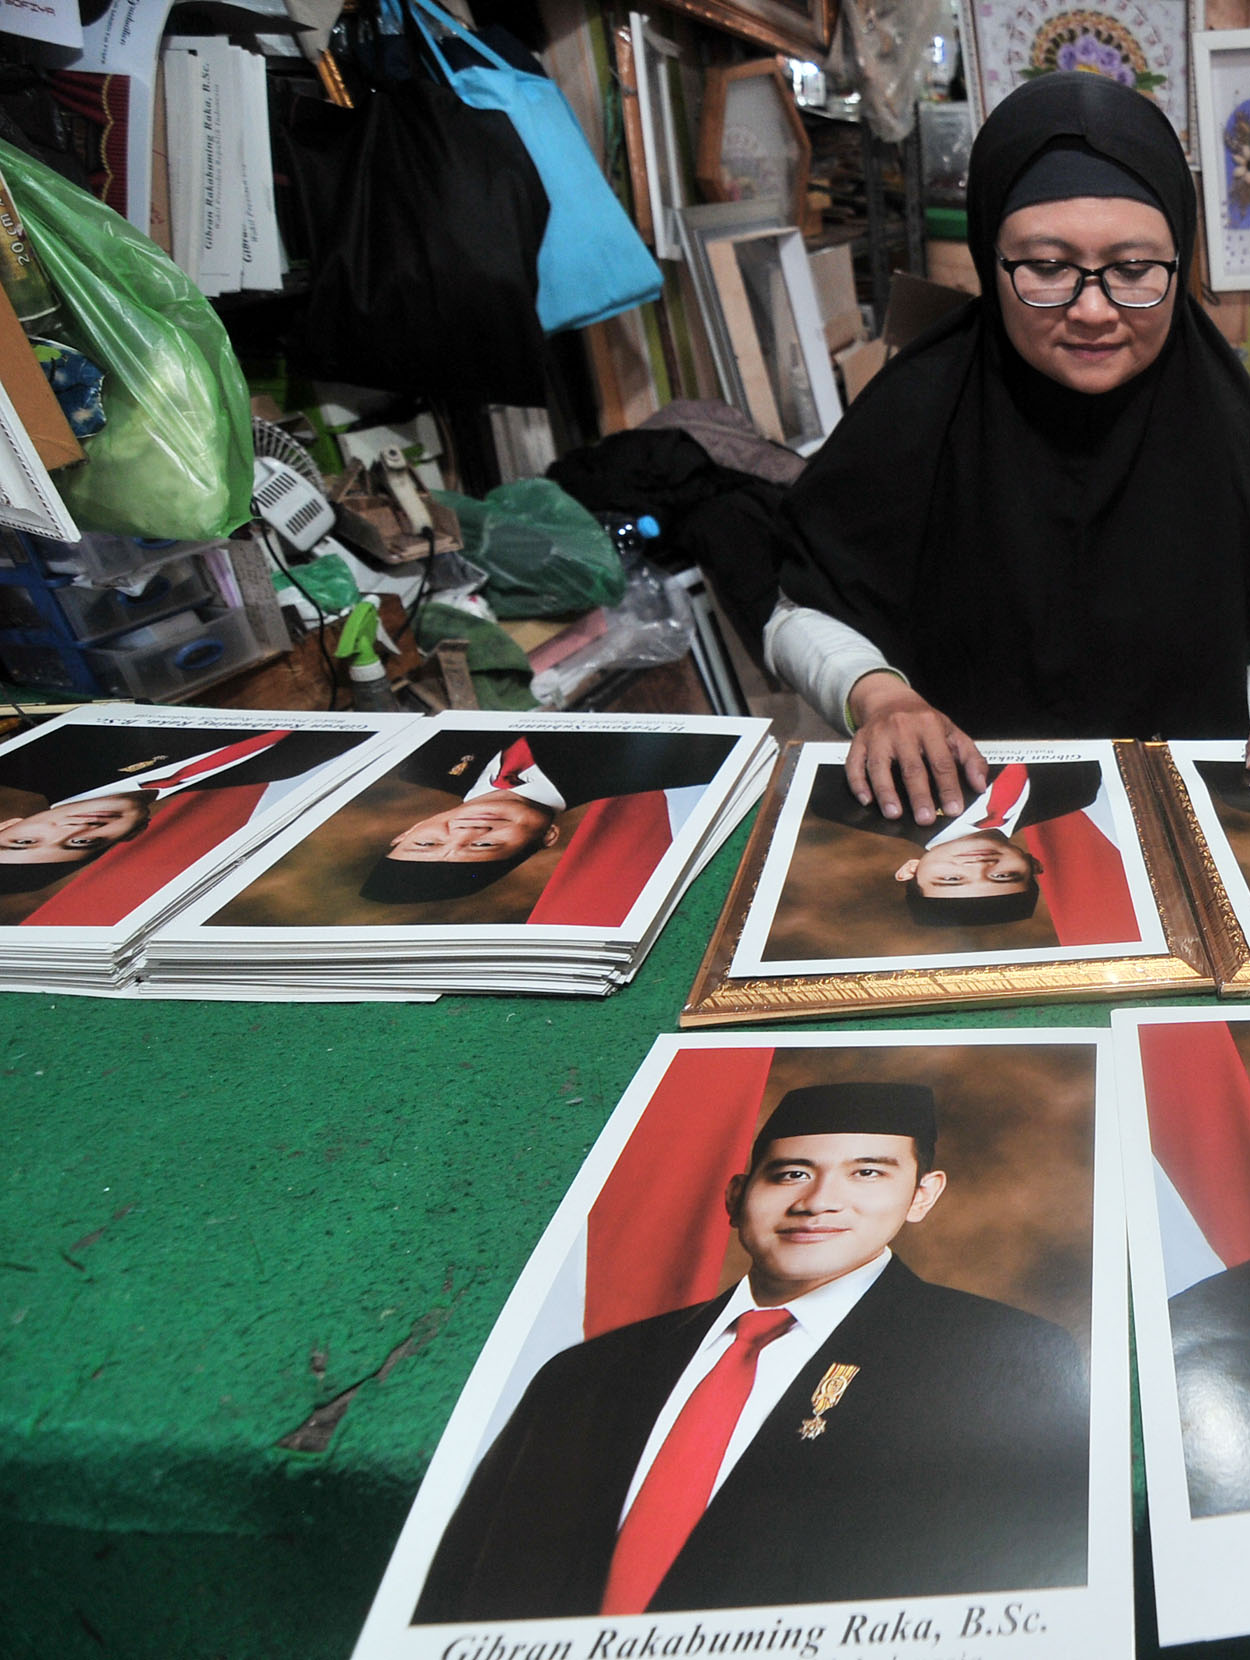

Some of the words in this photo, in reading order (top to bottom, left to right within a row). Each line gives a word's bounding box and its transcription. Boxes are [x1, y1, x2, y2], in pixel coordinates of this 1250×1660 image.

[204, 211, 214, 250] Gibran
[10, 241, 32, 266] 20
[441, 1633, 574, 1660] Gibran
[587, 1618, 825, 1660] Rakabuming
[839, 1610, 942, 1648] Raka,
[959, 1600, 1048, 1639] B.Sc.
